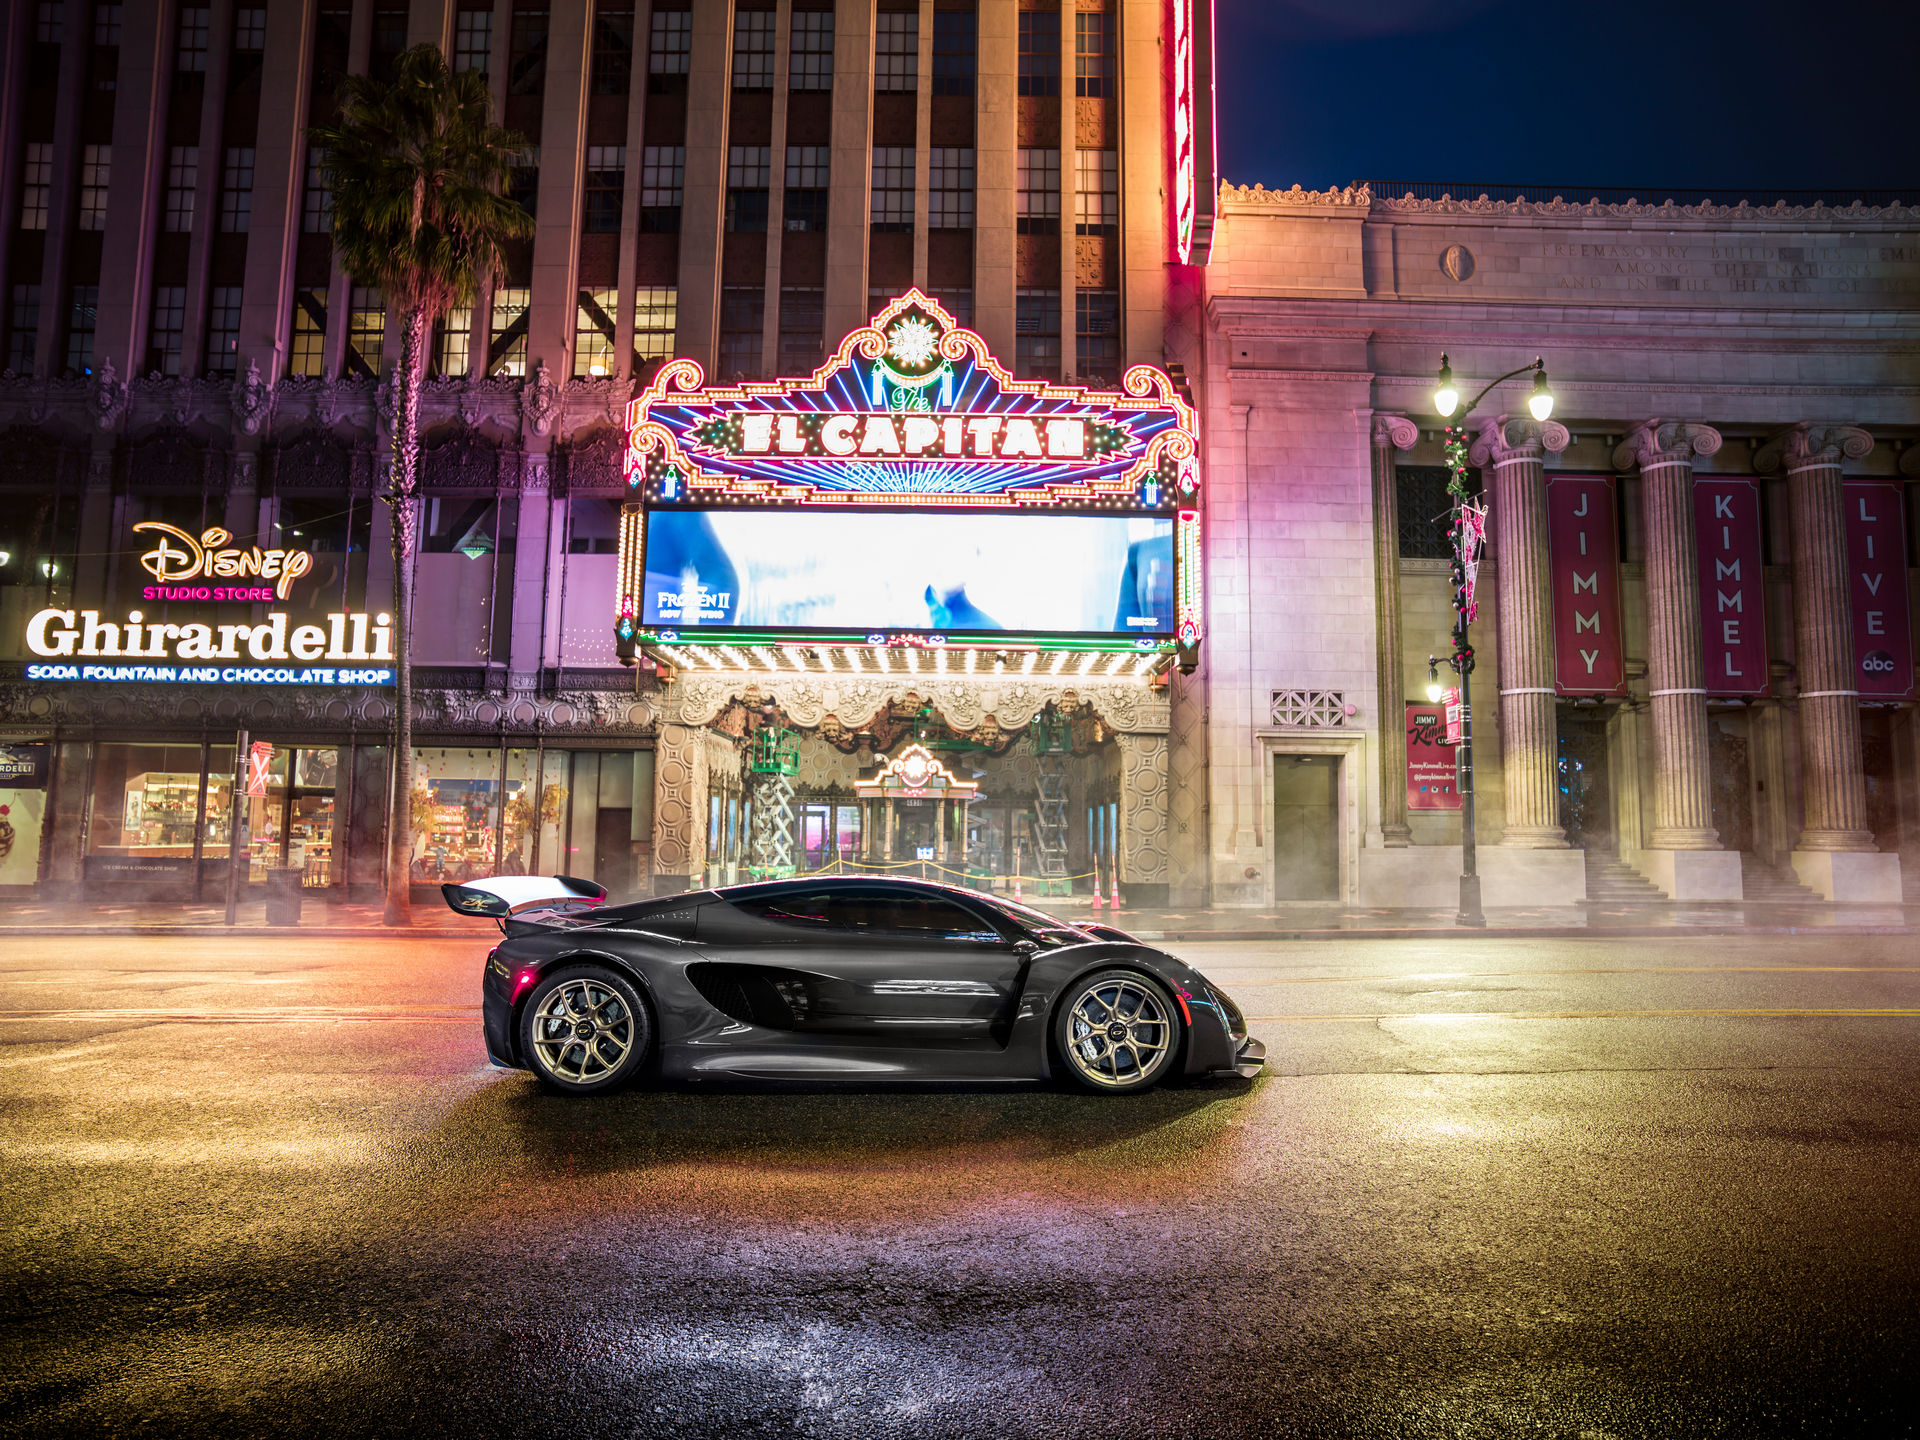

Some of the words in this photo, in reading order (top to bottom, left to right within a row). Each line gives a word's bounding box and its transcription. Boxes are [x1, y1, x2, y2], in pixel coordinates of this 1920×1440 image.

[1543, 244, 1689, 259] FREEMASONRY
[1614, 261, 1689, 275] AMONG
[1711, 263, 1752, 276] THE
[1775, 263, 1872, 277] NATIONS
[1560, 277, 1602, 289] AND
[1627, 278, 1649, 290] IN
[1672, 279, 1712, 291] THE
[890, 386, 932, 412] The
[740, 414, 806, 454] EL
[820, 414, 1085, 457] CAPITAN
[1859, 497, 1886, 636] LIVE
[1572, 492, 1601, 675] JIMMY
[1714, 494, 1744, 677] KIMMEL
[143, 586, 209, 600] STUDIO
[213, 586, 274, 601] STORE
[26, 608, 394, 661] Ghirardelli
[1862, 656, 1895, 671] abc
[28, 665, 78, 680] SODA
[83, 665, 176, 682] FOUNTAIN
[179, 667, 219, 682] AND
[222, 667, 335, 684] CHOCOLATE
[338, 668, 391, 684] SHOP
[1415, 716, 1436, 724] JIMMY
